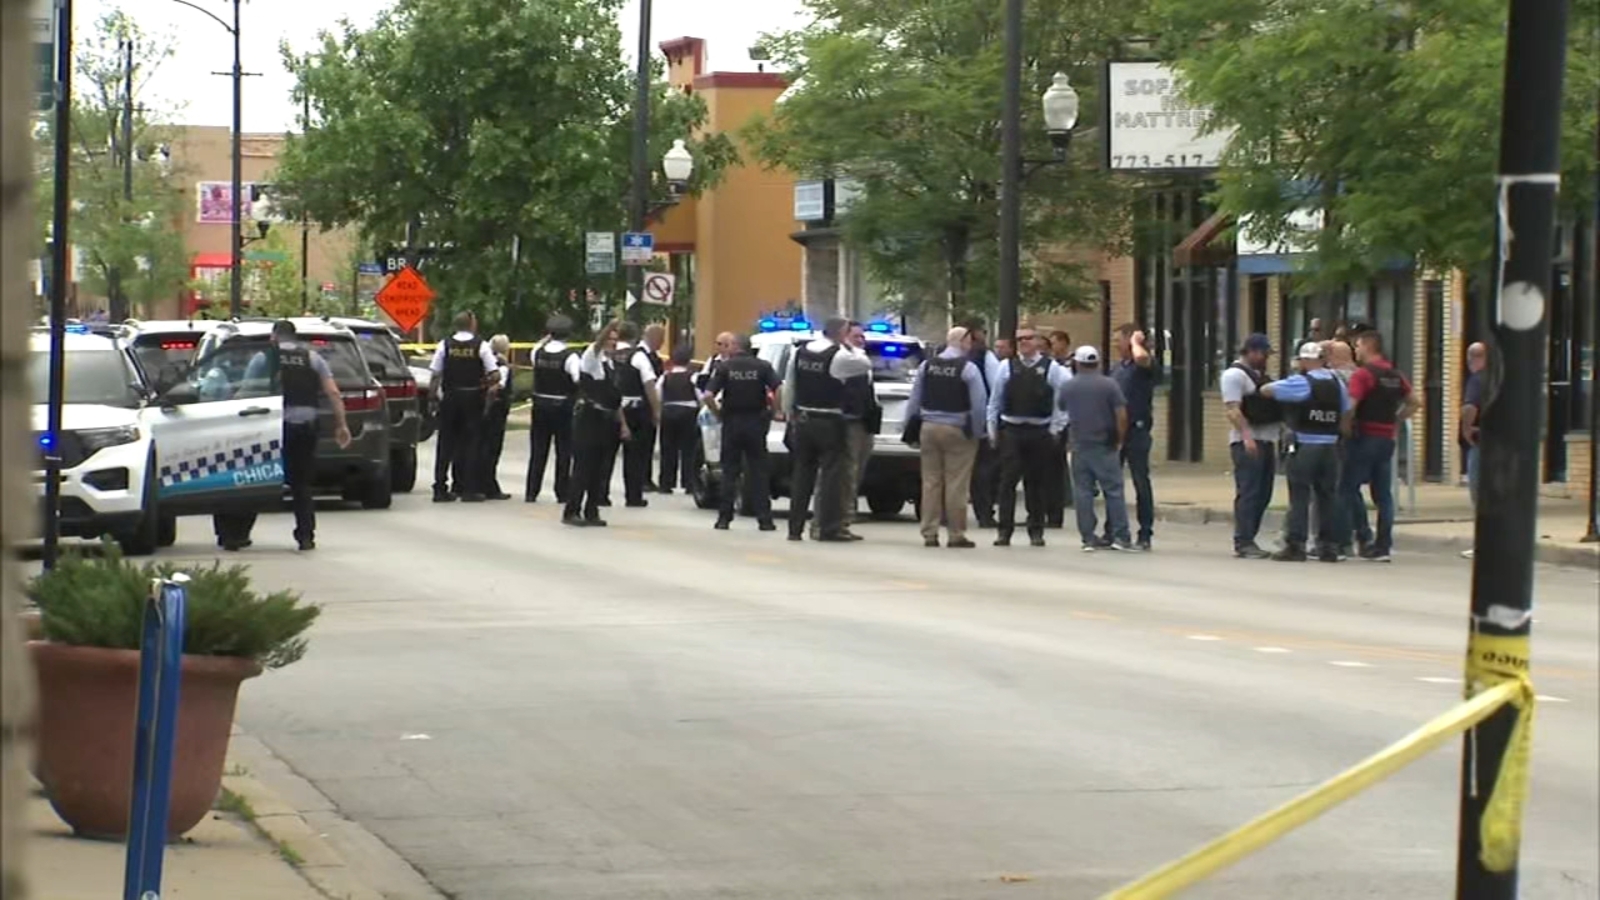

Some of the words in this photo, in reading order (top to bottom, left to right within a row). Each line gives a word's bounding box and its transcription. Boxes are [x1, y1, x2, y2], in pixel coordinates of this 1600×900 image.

[448, 347, 475, 358] POLICE
[279, 354, 305, 366] OLICE
[797, 359, 824, 371] POLICE
[729, 369, 759, 381] POLICE
[929, 364, 957, 377] POLICE
[1309, 409, 1337, 422] POLICE
